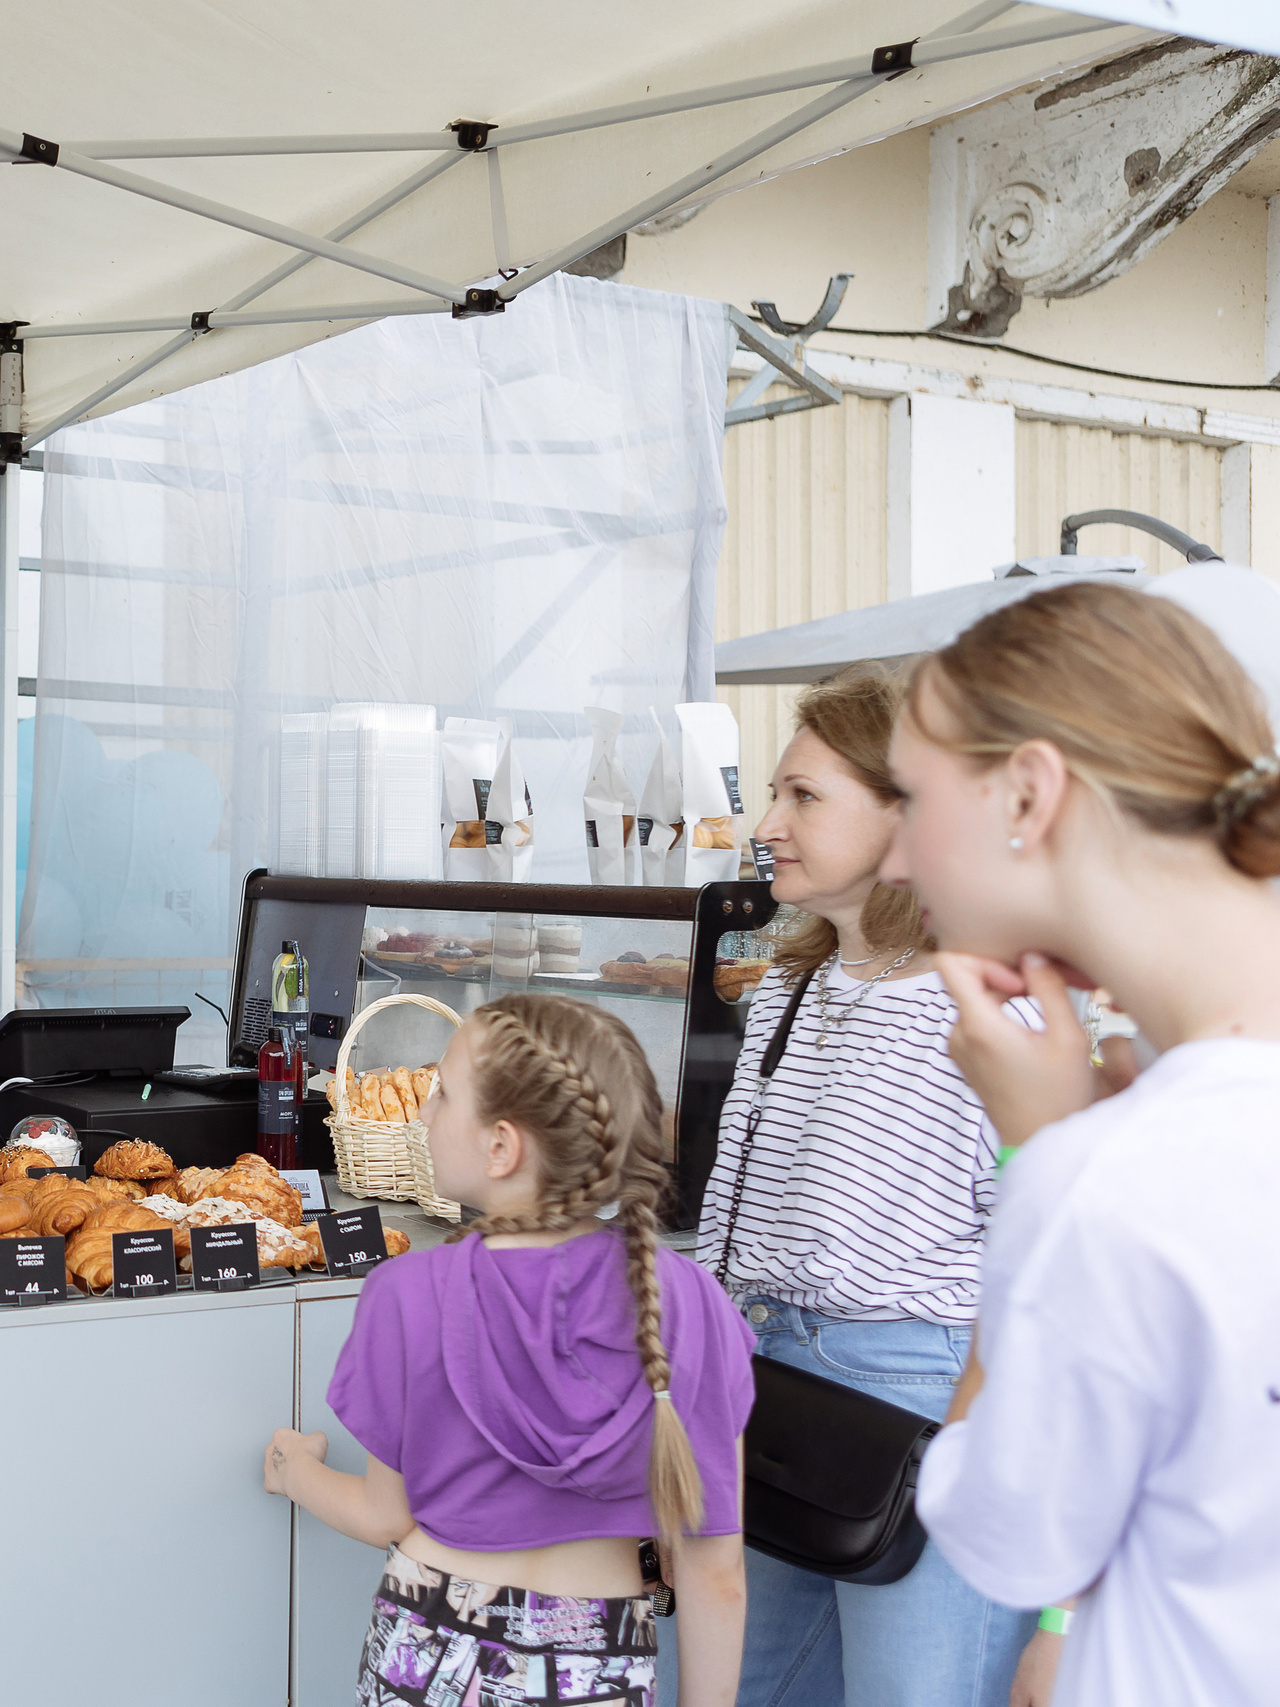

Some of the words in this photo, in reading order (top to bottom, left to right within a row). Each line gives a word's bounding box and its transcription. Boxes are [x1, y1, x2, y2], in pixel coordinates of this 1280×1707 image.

[349, 1251, 367, 1263] 150
[217, 1267, 237, 1279] 160
[135, 1274, 154, 1285] 100
[25, 1282, 39, 1293] 44
